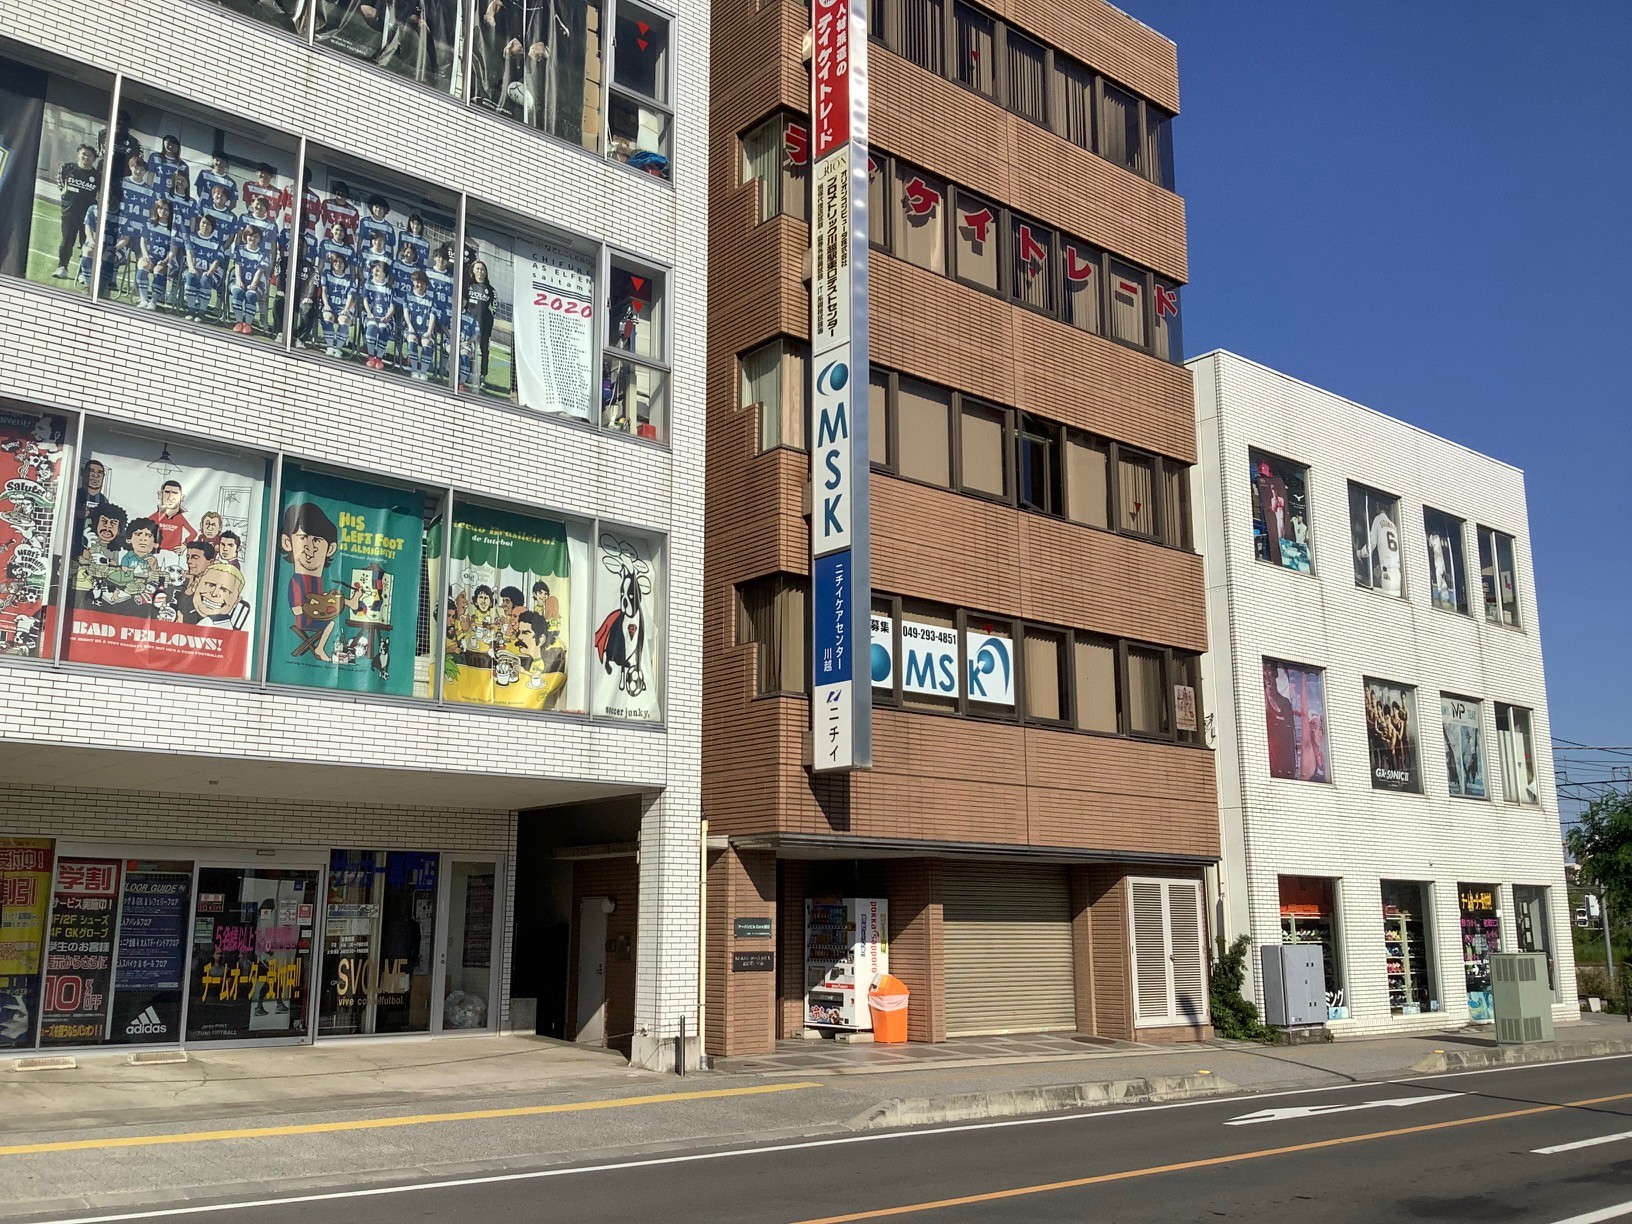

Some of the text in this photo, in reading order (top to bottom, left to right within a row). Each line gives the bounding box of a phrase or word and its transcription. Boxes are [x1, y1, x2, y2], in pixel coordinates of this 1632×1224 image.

[836, 3, 847, 76] 人材派遣の
[67, 176, 97, 191] SVOLME
[127, 203, 140, 215] 14
[152, 245, 166, 257] 23
[245, 271, 253, 281] 6
[532, 262, 592, 285] AS ELFEN
[331, 294, 341, 306] 10
[436, 291, 446, 302] 16
[533, 293, 592, 318] 2020
[376, 304, 383, 314] 5
[817, 401, 848, 538] MSK
[5, 480, 47, 498] Salute!
[338, 511, 361, 531] HIS
[341, 528, 405, 551] LEFT FOOT
[471, 534, 514, 547] de futebol
[1386, 530, 1398, 552] 6
[339, 542, 396, 560] IS ALMIGHTY!
[835, 563, 844, 670] ニチイケアセンター
[72, 620, 224, 653] BAD FELLOWS!
[902, 625, 957, 645] 049-293-4851
[823, 647, 832, 672] 川越
[828, 707, 840, 762] ニチイ
[57, 865, 114, 891] 学割
[124, 881, 177, 893] LOOR GUIDE
[80, 915, 109, 926] シューズ
[82, 994, 103, 1011] OFF
[338, 996, 355, 1007] vive
[125, 1022, 167, 1035] adidas
